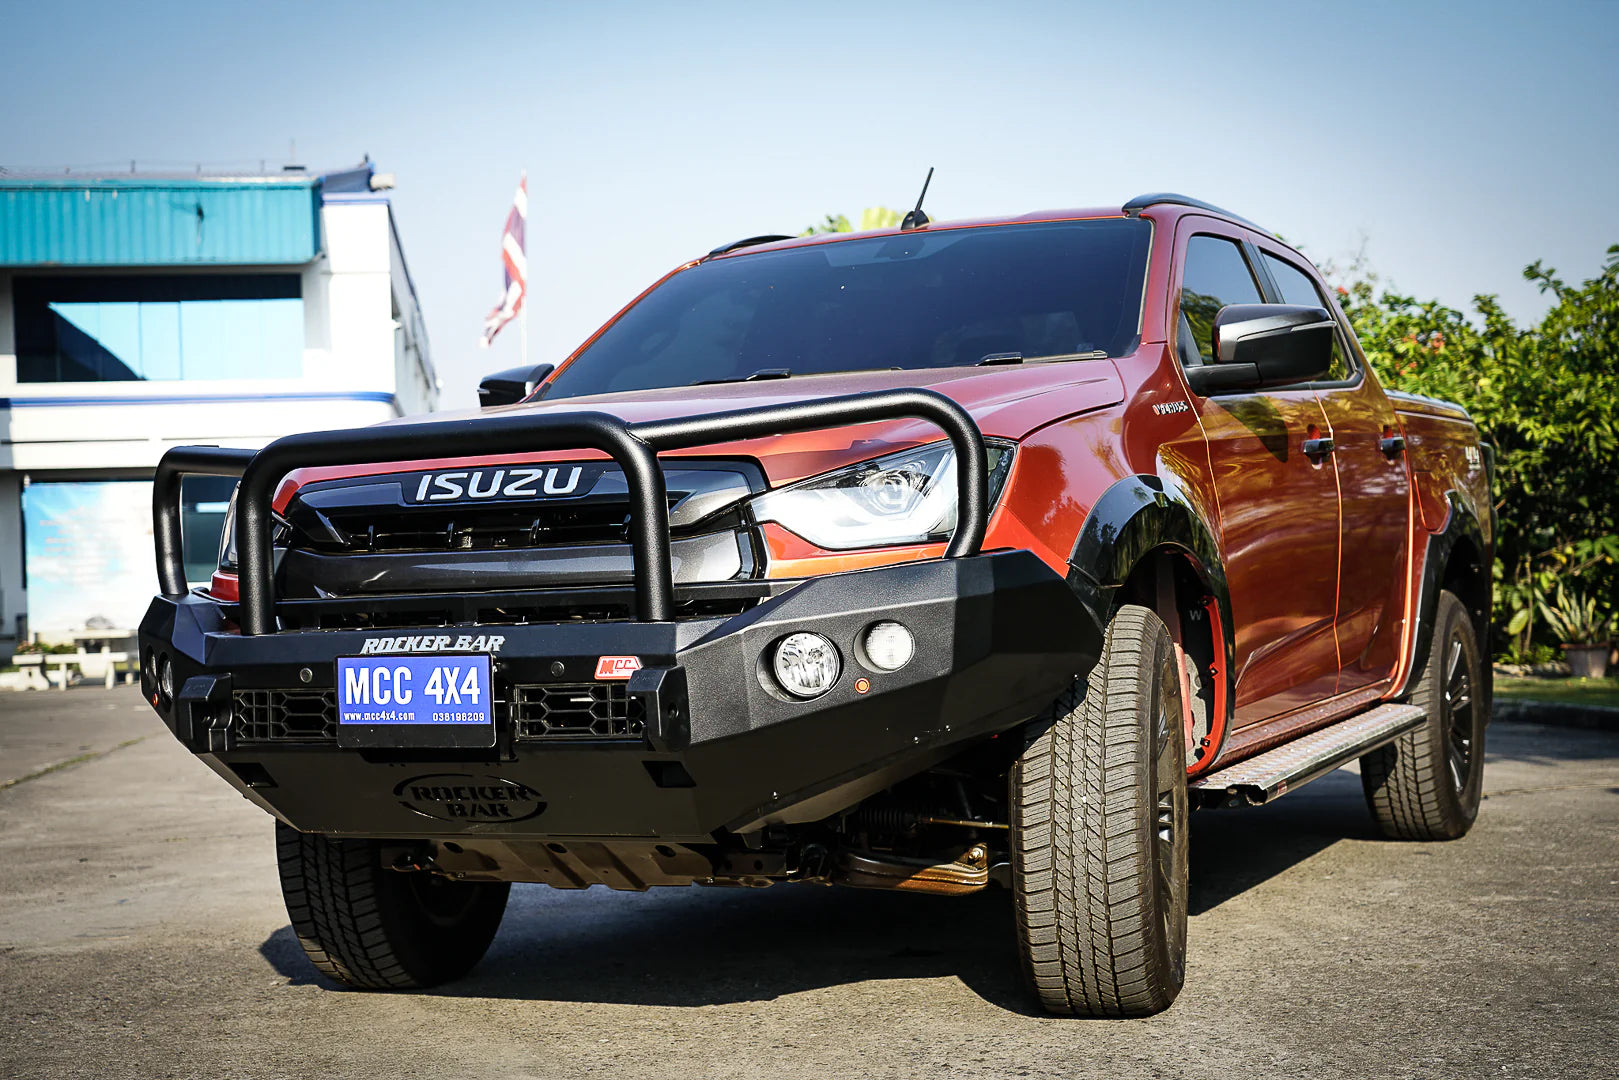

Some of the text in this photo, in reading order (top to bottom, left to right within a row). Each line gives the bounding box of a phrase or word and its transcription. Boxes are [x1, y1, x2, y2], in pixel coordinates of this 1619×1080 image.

[415, 466, 583, 502] ISUZU
[360, 635, 506, 655] ROCKER BAR
[599, 659, 637, 674] MCC
[345, 666, 481, 705] MCC 4X4
[343, 710, 485, 722] www.mcc4x4.com 038198209
[410, 786, 533, 801] ROCKER
[446, 803, 514, 818] BAR
